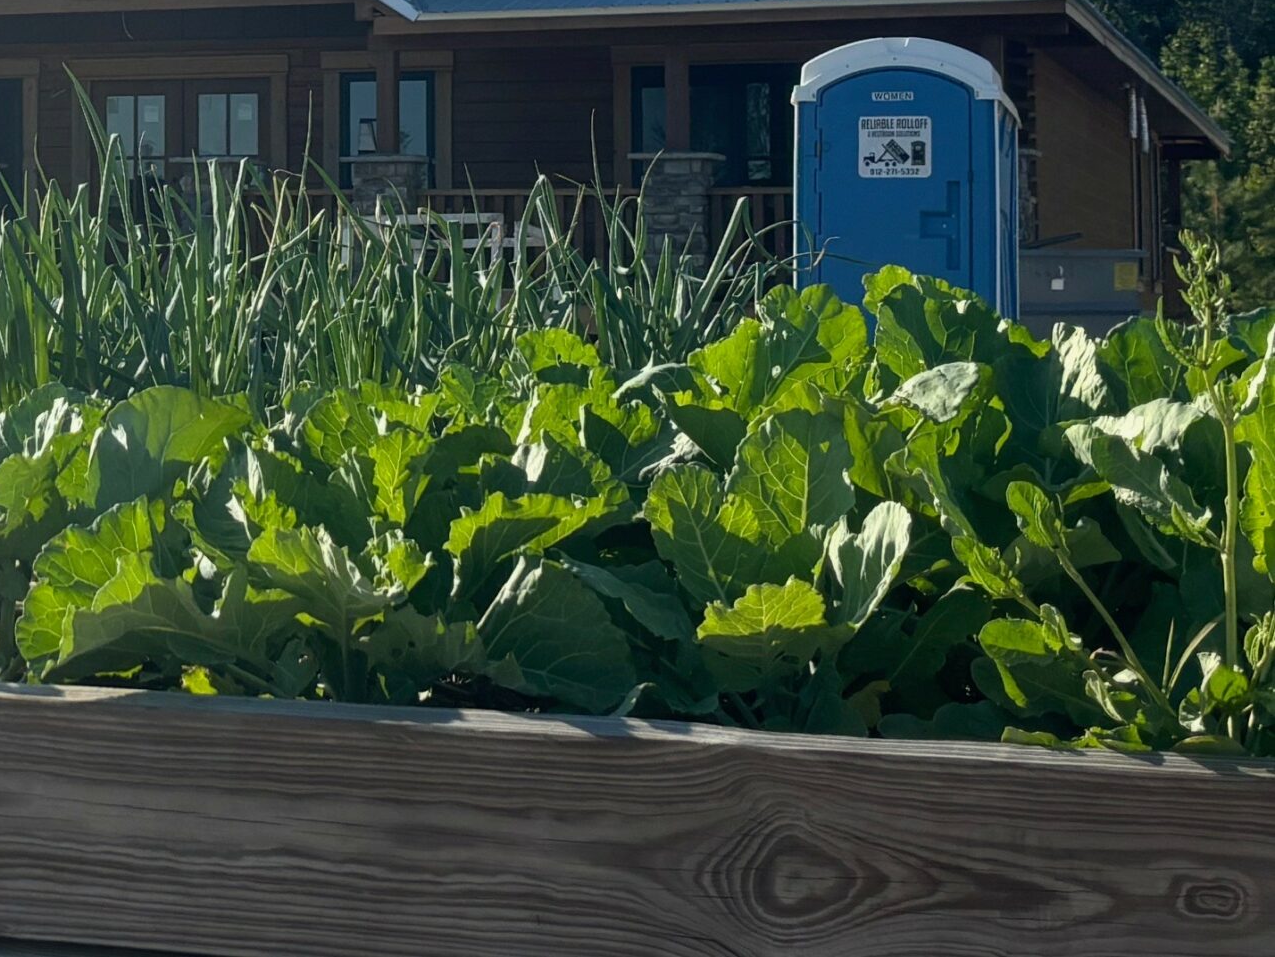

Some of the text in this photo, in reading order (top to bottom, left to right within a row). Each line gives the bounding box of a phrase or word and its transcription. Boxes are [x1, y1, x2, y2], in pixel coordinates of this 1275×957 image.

[874, 92, 912, 100] WOMEN
[861, 118, 928, 129] RELIABLE ROLLOFF
